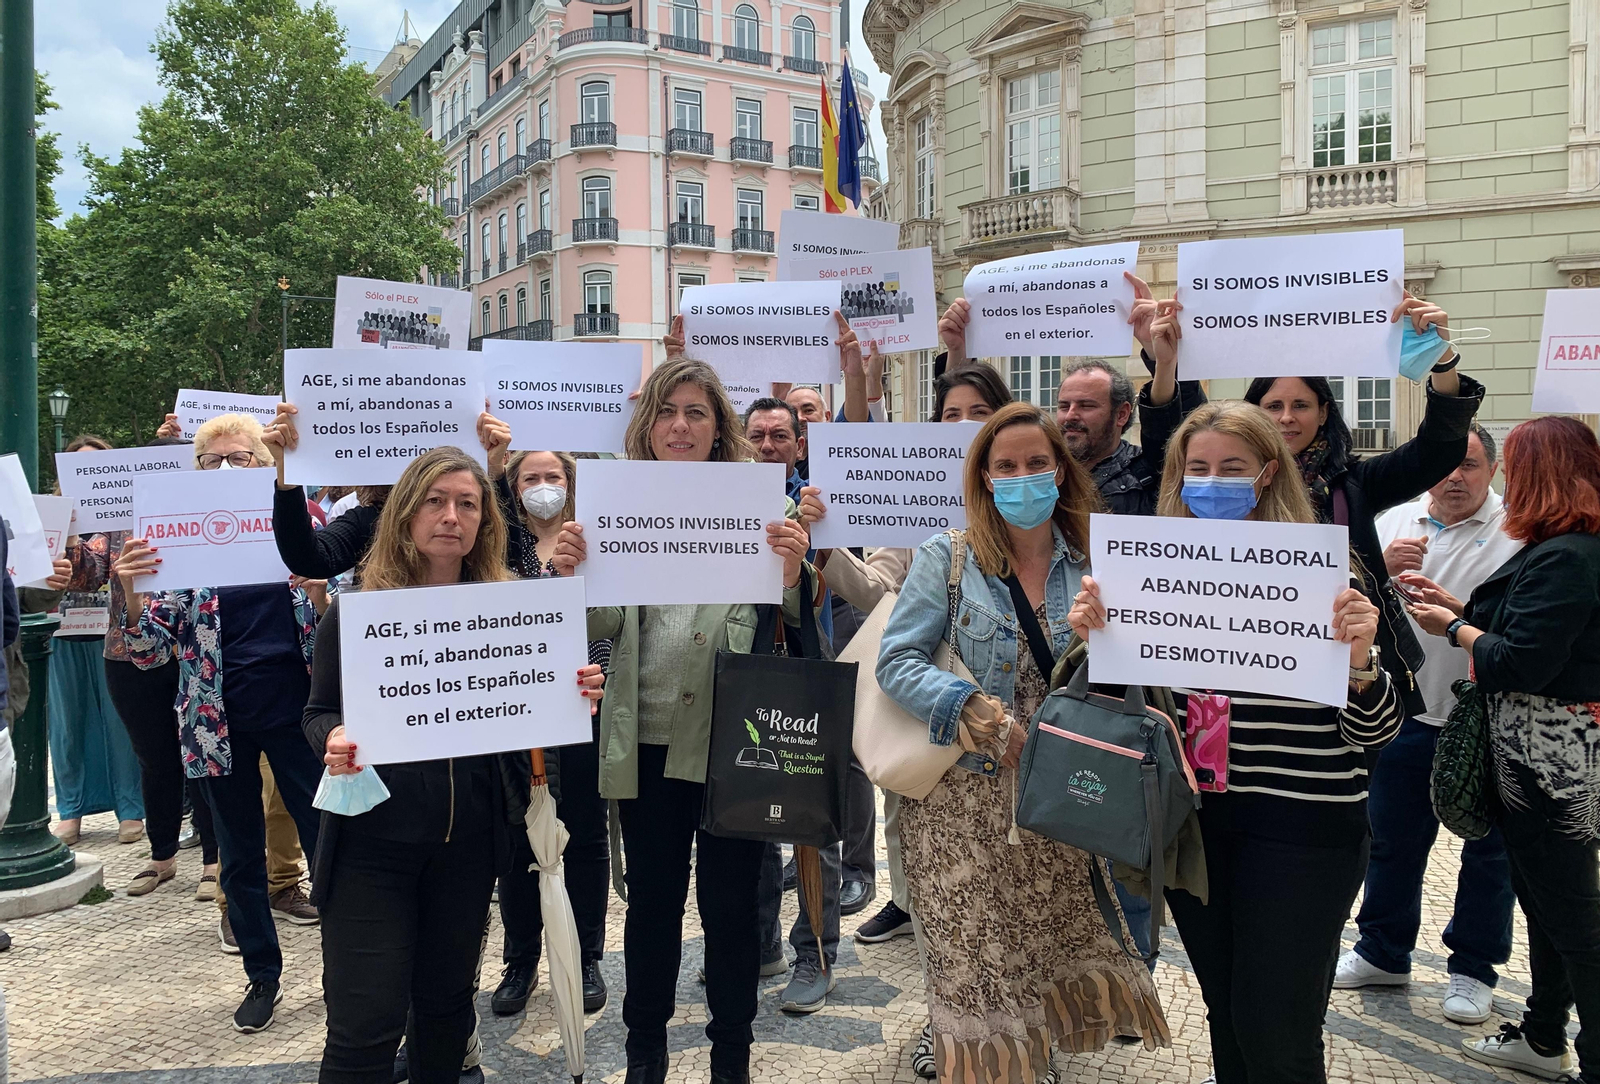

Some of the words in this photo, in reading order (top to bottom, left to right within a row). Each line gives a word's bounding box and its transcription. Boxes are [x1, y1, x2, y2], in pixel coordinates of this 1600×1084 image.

[803, 244, 837, 254] SOMOS
[819, 269, 838, 278] Sólo
[841, 268, 847, 276] el
[850, 266, 872, 275] PLEX
[978, 266, 1008, 275] AGE,
[1052, 258, 1125, 268] abandonas
[1193, 278, 1207, 290] SI
[1214, 277, 1279, 290] SOMOS
[1286, 270, 1388, 287] INVISIBLES
[1000, 282, 1018, 294] mí,
[1023, 280, 1095, 291] abandonas
[365, 291, 384, 300] Sólo
[396, 295, 418, 304] PLEX
[691, 306, 702, 314] SI
[707, 306, 754, 315] SOMOS
[759, 306, 830, 315] INVISIBLES
[982, 307, 1018, 317] todos
[1022, 306, 1041, 315] los
[1046, 303, 1115, 317] Españoles
[1194, 316, 1258, 328] SOMOS
[1265, 310, 1386, 327] INSERVIBLES
[878, 337, 885, 345] al
[888, 334, 910, 344] PLEX
[1025, 329, 1034, 339] el
[1040, 328, 1093, 339] exterior.
[692, 335, 738, 345] SOMOS
[744, 336, 828, 346] INSERVIBLES
[302, 375, 336, 388] AGE,
[342, 374, 352, 386] si
[359, 377, 380, 386] me
[386, 374, 466, 386] abandonas
[498, 381, 508, 390] SI
[512, 381, 557, 391] SOMOS
[562, 383, 623, 393] INVISIBLES
[722, 384, 760, 393] spañoles
[181, 401, 200, 409] AGE,
[229, 405, 275, 414] abandonas
[318, 402, 325, 410] a
[331, 398, 353, 412] mí,
[359, 398, 440, 410] abandonas
[445, 400, 452, 409] a
[499, 400, 543, 410] SOMOS
[548, 402, 621, 413] INSERVIBLES
[313, 422, 355, 434] todos
[361, 422, 380, 434] los
[386, 421, 458, 436] Españoles
[335, 450, 352, 458] en
[358, 446, 370, 458] el
[829, 447, 898, 458] PERSONAL
[903, 448, 964, 458] LABORAL
[76, 465, 131, 475] PERSONAL
[135, 462, 181, 471] LABORAL
[846, 470, 946, 482] ABANDONADO
[92, 480, 133, 490] ABAND
[830, 494, 899, 505] PERSONAL
[904, 494, 966, 506] LABORAL
[598, 516, 610, 528] SI
[616, 517, 674, 529] SOMOS
[680, 518, 761, 530] INVISIBLES
[848, 515, 948, 528] DESMOTIVADO
[600, 541, 658, 553] SOMOS
[664, 542, 758, 554] INSERVIBLES
[1108, 540, 1223, 561] PERSONAL
[1231, 547, 1338, 568] LABORAL
[1141, 578, 1298, 601] ABANDONADO
[365, 622, 408, 639] AGE,
[414, 620, 426, 635] si
[434, 621, 461, 633] me
[468, 612, 563, 630] abandonas
[1107, 608, 1221, 630] PERSONAL
[1229, 617, 1334, 640] LABORAL
[385, 657, 394, 667] a
[401, 650, 428, 667] mí,
[435, 644, 532, 663] abandonas
[538, 643, 546, 653] a
[1141, 644, 1296, 670] DESMOTIVADO
[379, 681, 430, 698] todos
[437, 678, 461, 693] los
[468, 669, 554, 692] Españoles
[407, 714, 428, 726] en
[435, 708, 449, 723] el
[456, 702, 531, 721] exterior.
[756, 708, 769, 721] To
[770, 709, 818, 734] Read
[777, 734, 789, 743] Not
[798, 737, 817, 745] Read?
[778, 750, 793, 759] That
[805, 752, 825, 763] Stupid
[784, 761, 824, 774] Question
[1068, 775, 1079, 785] to
[1081, 780, 1107, 794] enjoy
